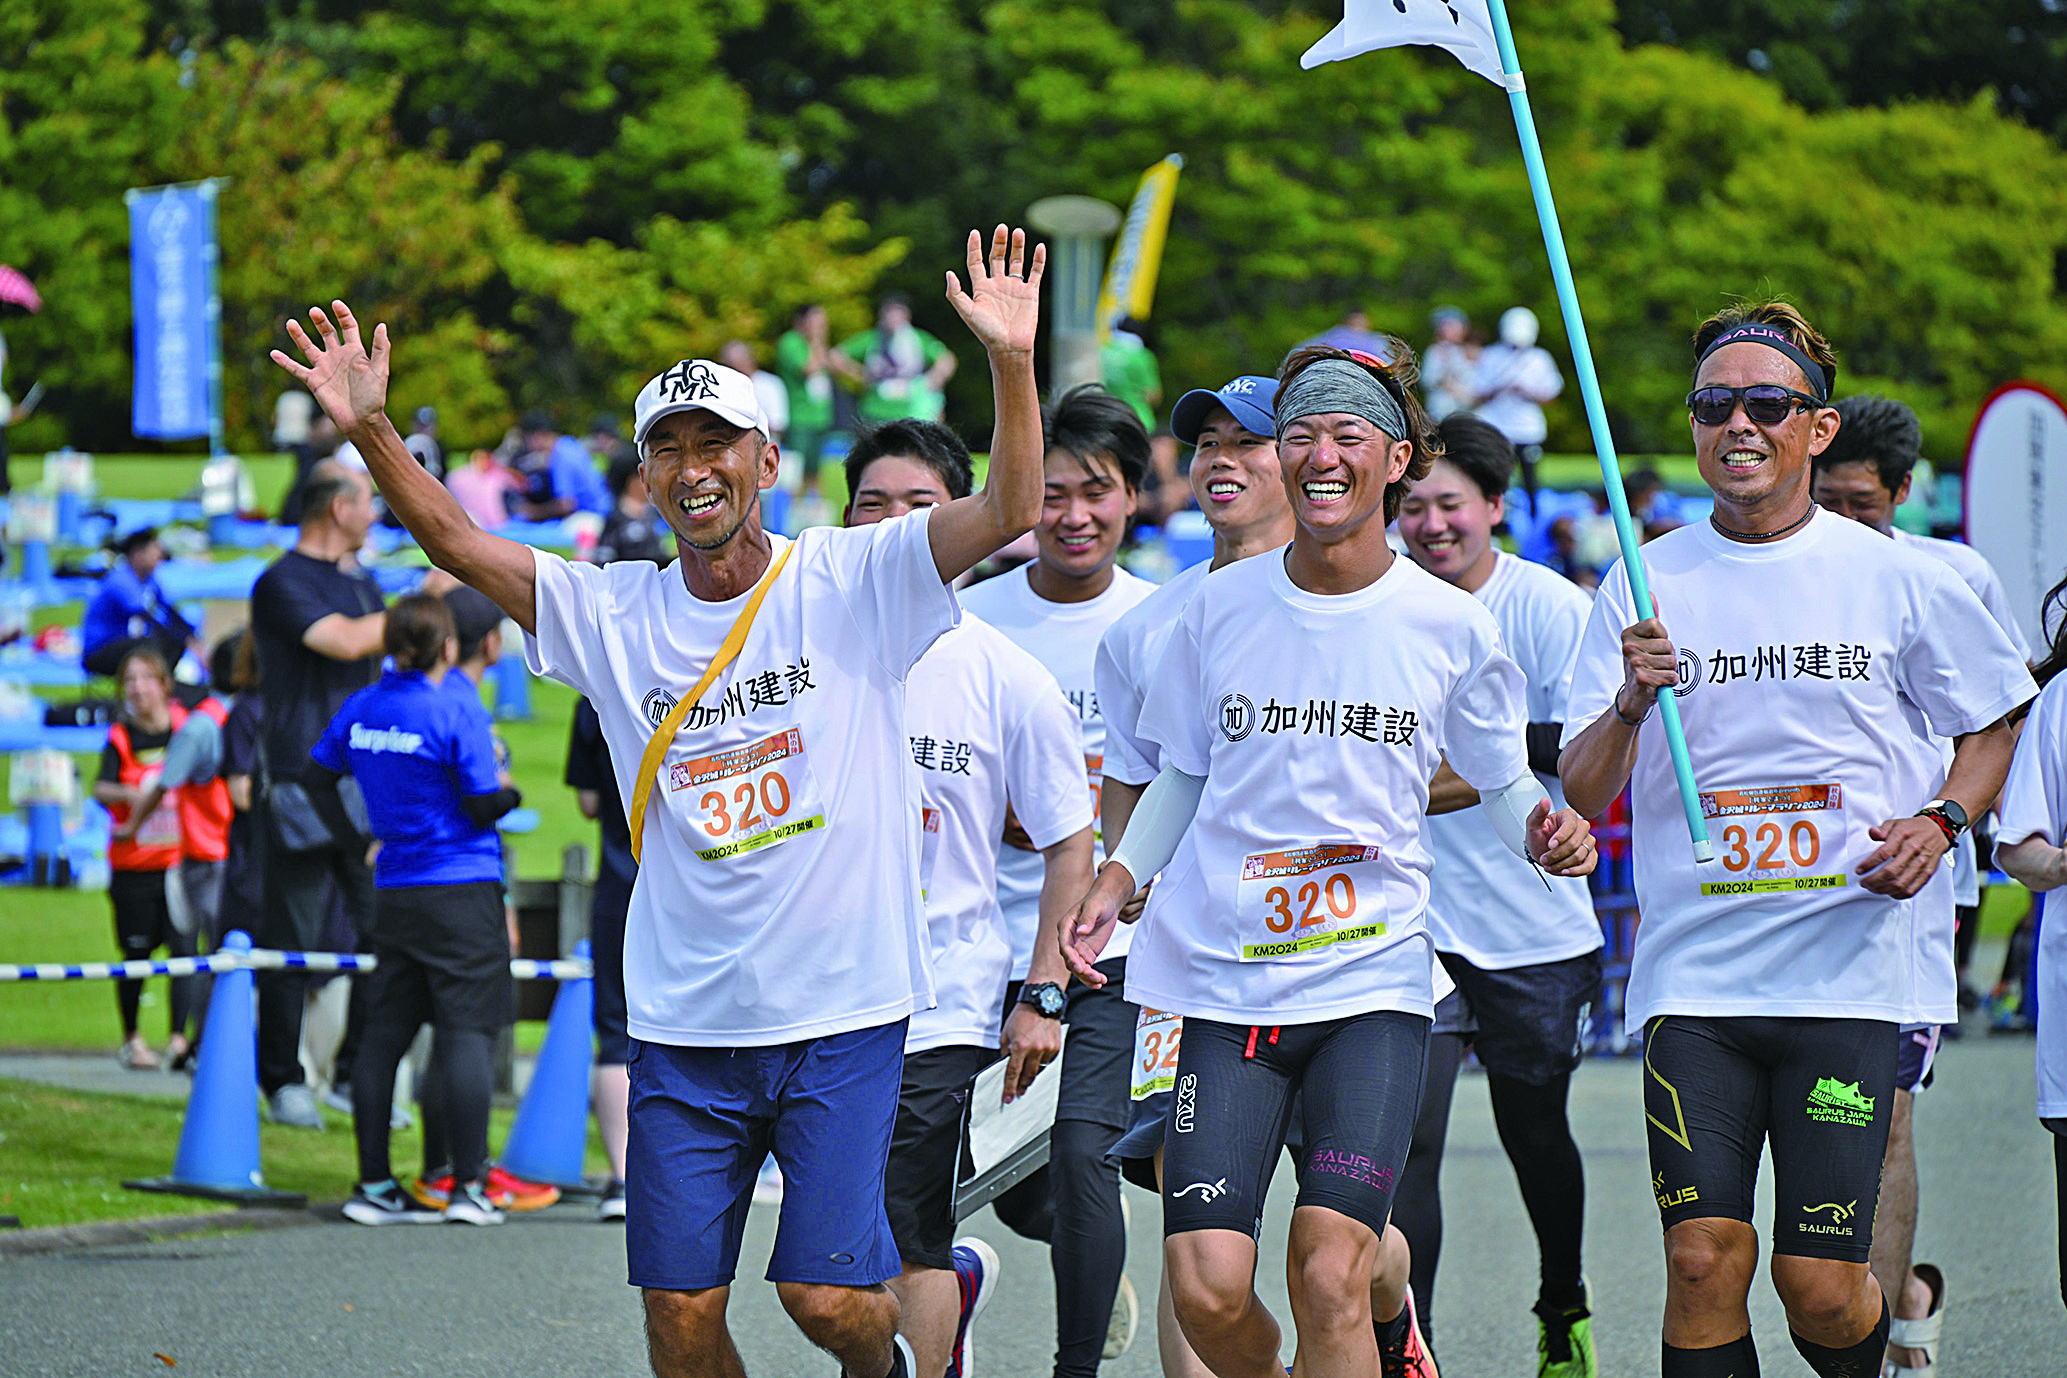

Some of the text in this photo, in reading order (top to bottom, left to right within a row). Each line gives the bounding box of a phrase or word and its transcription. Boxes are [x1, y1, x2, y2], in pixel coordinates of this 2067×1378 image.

[1717, 328, 1800, 351] SAUR
[1221, 379, 1257, 394] NYC
[1708, 643, 1872, 684] 加州建設
[684, 656, 817, 730] 加州建設
[1261, 698, 1419, 746] 加州建設
[701, 771, 790, 836] 320
[1722, 820, 1820, 872] 320
[1265, 873, 1356, 933] 320
[1175, 1073, 1197, 1133] 2XU
[1806, 1107, 1874, 1121] SAURUS JAPAN
[1812, 1114, 1867, 1127] KANAZAWA
[1313, 1149, 1395, 1183] SAURUS
[1799, 1223, 1853, 1236] SAURUS
